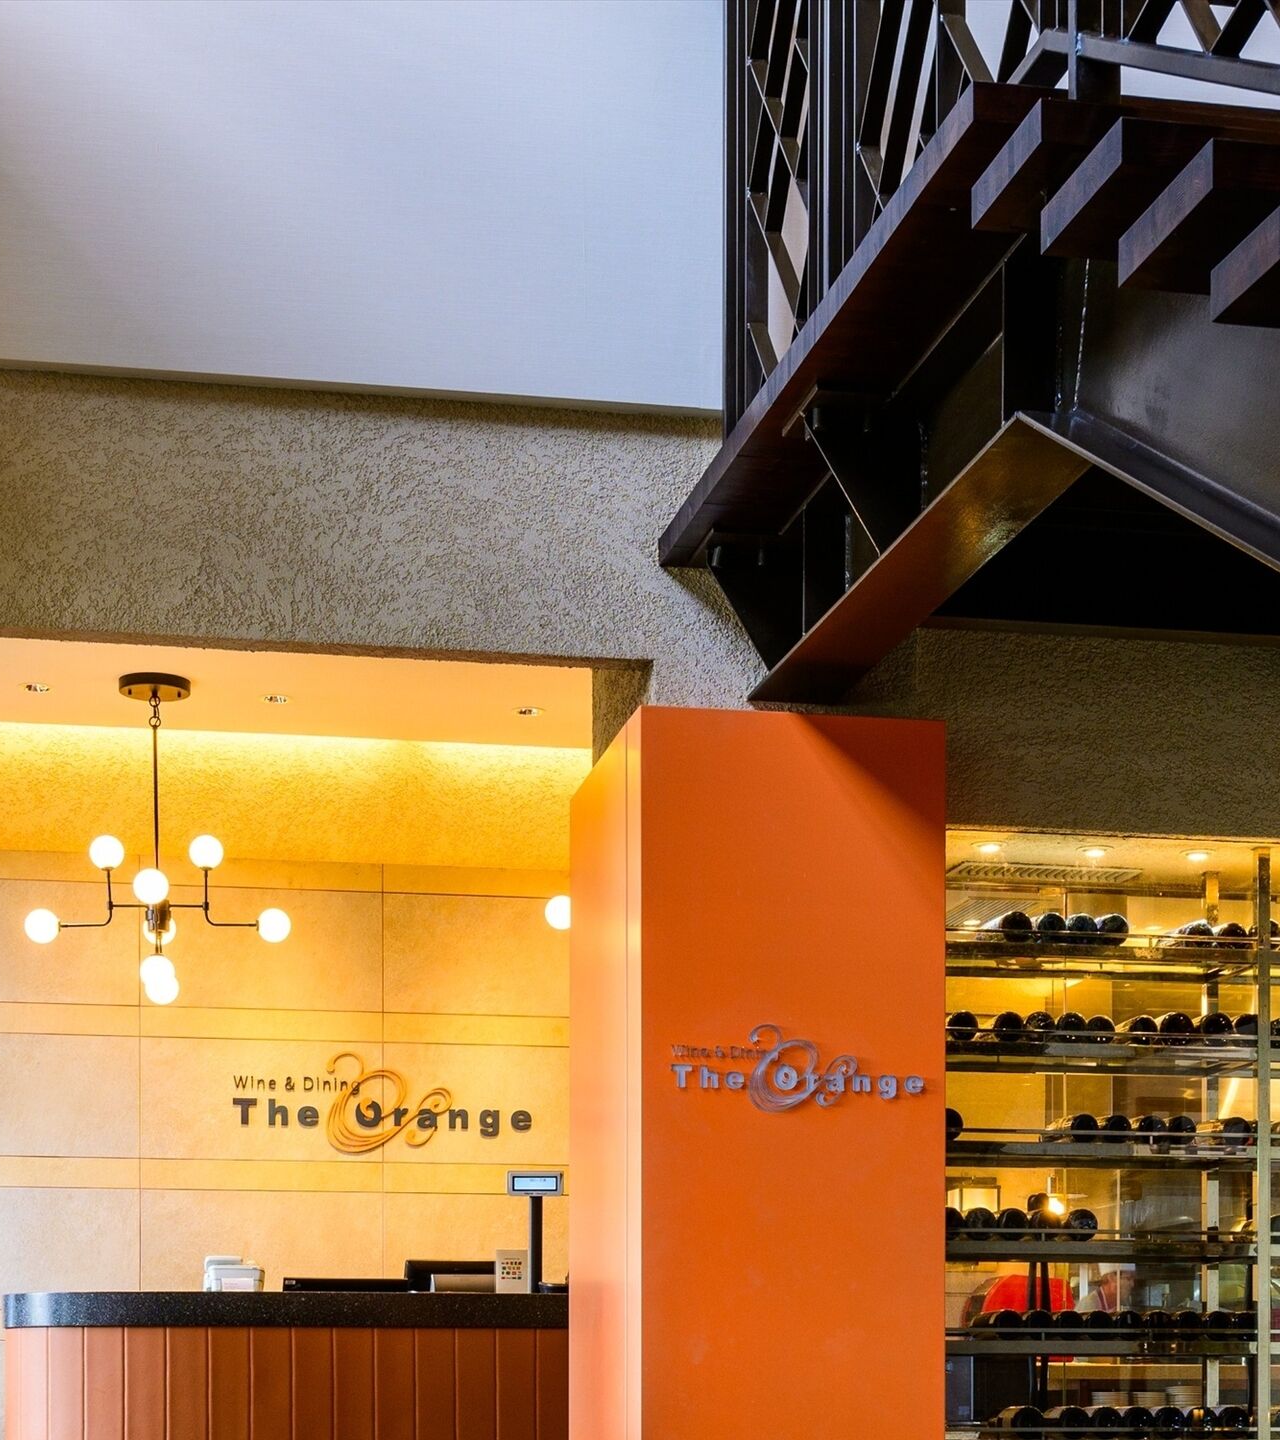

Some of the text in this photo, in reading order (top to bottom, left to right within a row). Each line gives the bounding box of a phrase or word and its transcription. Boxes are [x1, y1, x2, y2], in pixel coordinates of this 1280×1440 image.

[233, 1075, 361, 1095] Wine & Dining
[672, 1064, 924, 1099] The Orange
[233, 1097, 533, 1137] The Orange
